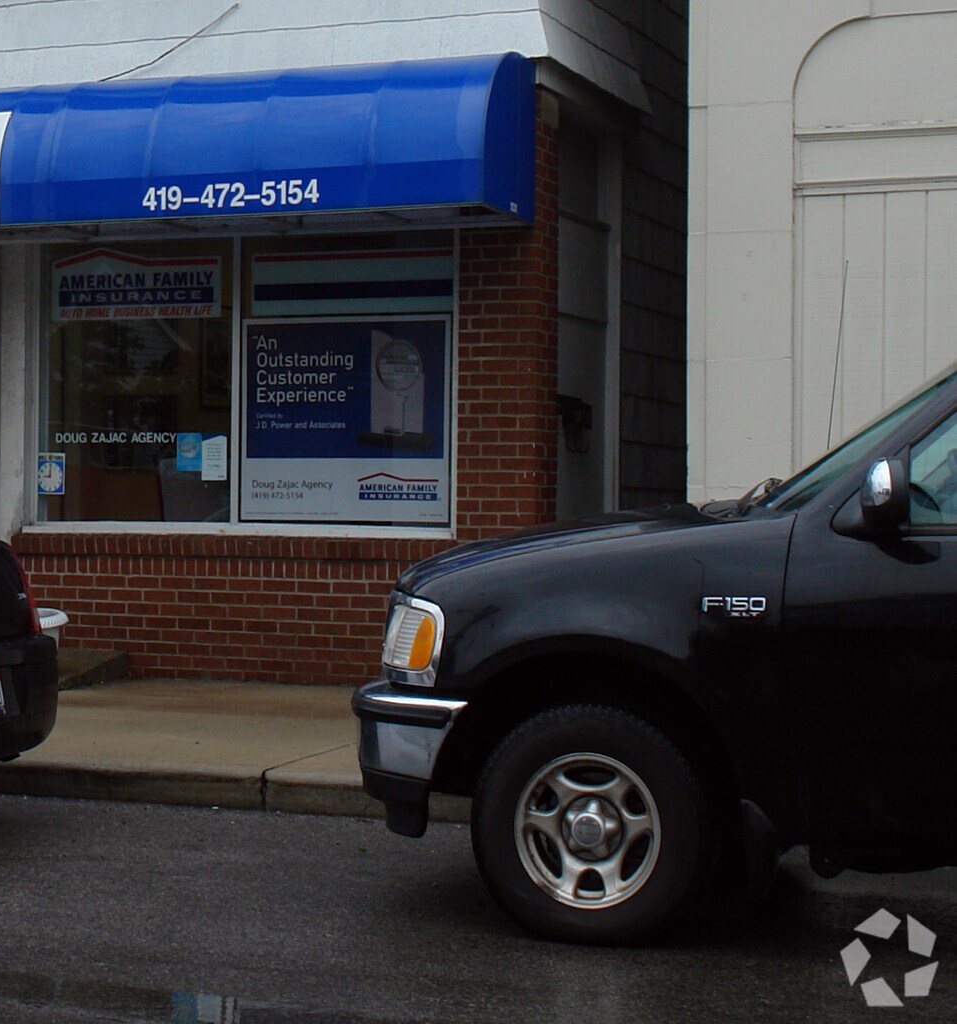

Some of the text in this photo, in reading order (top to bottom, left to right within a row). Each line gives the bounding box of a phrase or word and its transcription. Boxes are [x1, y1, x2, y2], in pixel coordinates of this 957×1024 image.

[142, 179, 320, 211] 419-472-5154
[59, 271, 213, 289] AMERICAN FAMILY
[70, 289, 203, 303] INSURANCE
[60, 305, 213, 318] AUTO HOME BUSINESS HEALTH LIFE
[256, 350, 354, 370] Outstanding
[256, 369, 337, 385] Customer
[271, 420, 293, 429] Power
[294, 420, 307, 429] and
[309, 420, 346, 429] Associates
[55, 432, 177, 444] DOUG ZAJAC AGENCY
[251, 480, 333, 491] Doug Zajac Agency
[359, 483, 437, 492] AMERICAN FAMILY
[251, 491, 304, 500] (419) 472-5154
